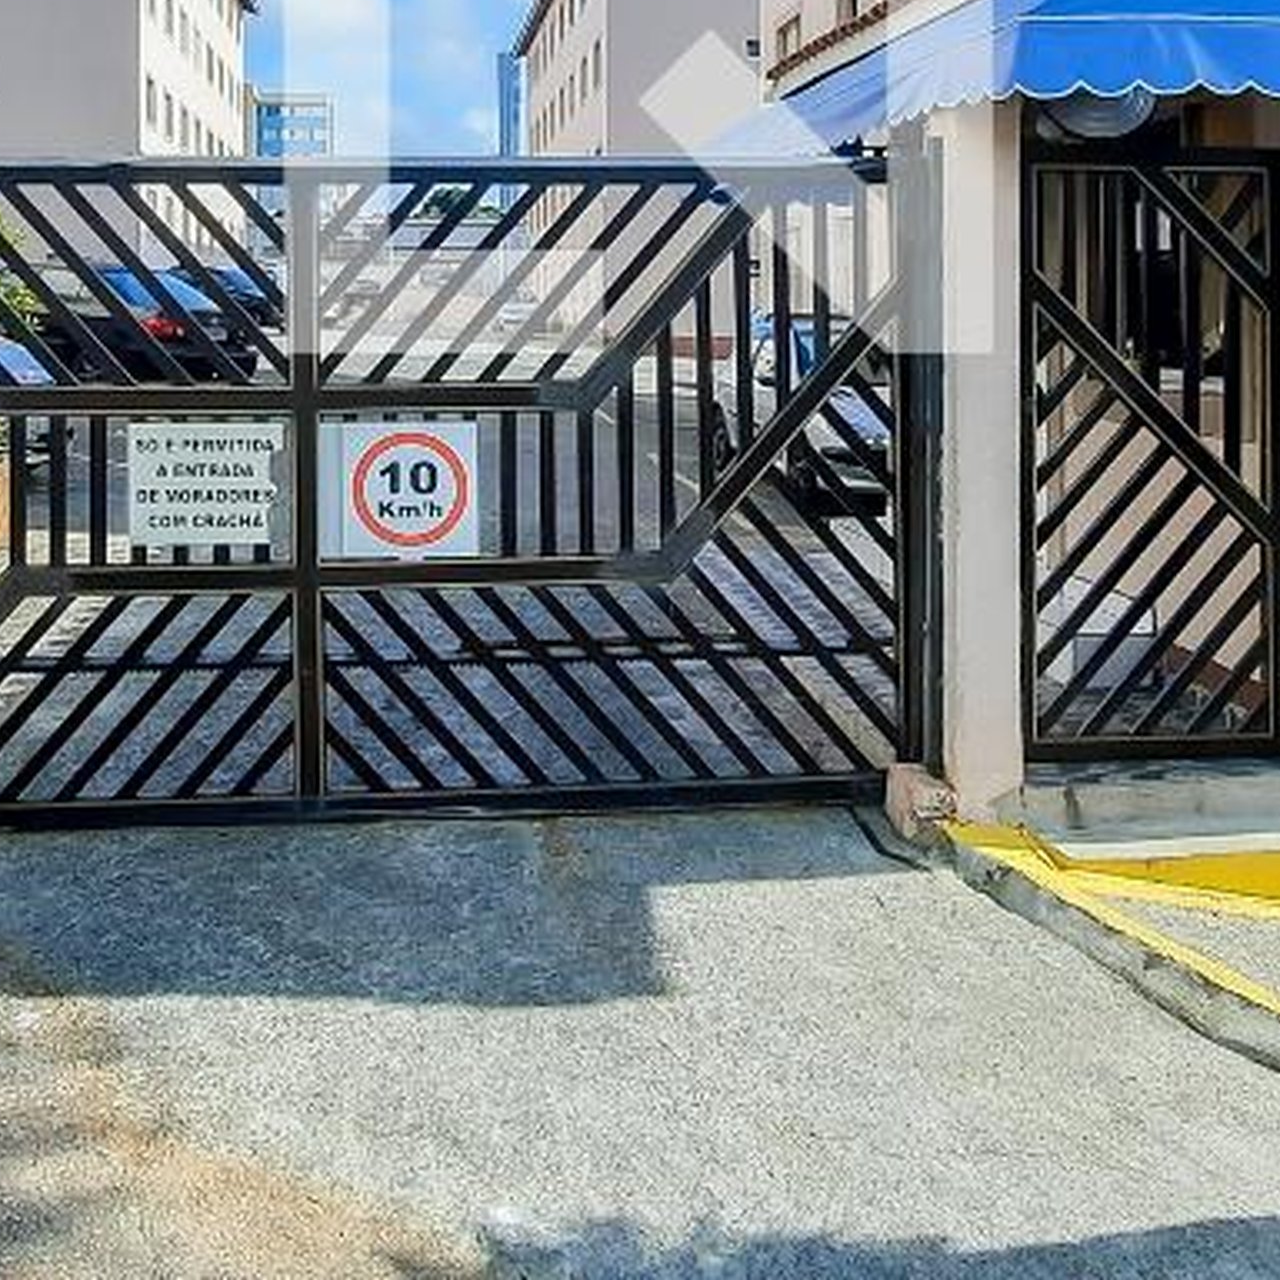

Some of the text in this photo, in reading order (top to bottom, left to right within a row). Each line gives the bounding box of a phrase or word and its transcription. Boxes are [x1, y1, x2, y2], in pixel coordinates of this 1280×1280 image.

[183, 438, 275, 453] PERMITIDA
[156, 463, 254, 477] A ENTRADA
[380, 461, 438, 494] 10
[136, 489, 276, 504] DE MORADORES
[379, 501, 443, 518] Km/h
[148, 515, 187, 528] COM
